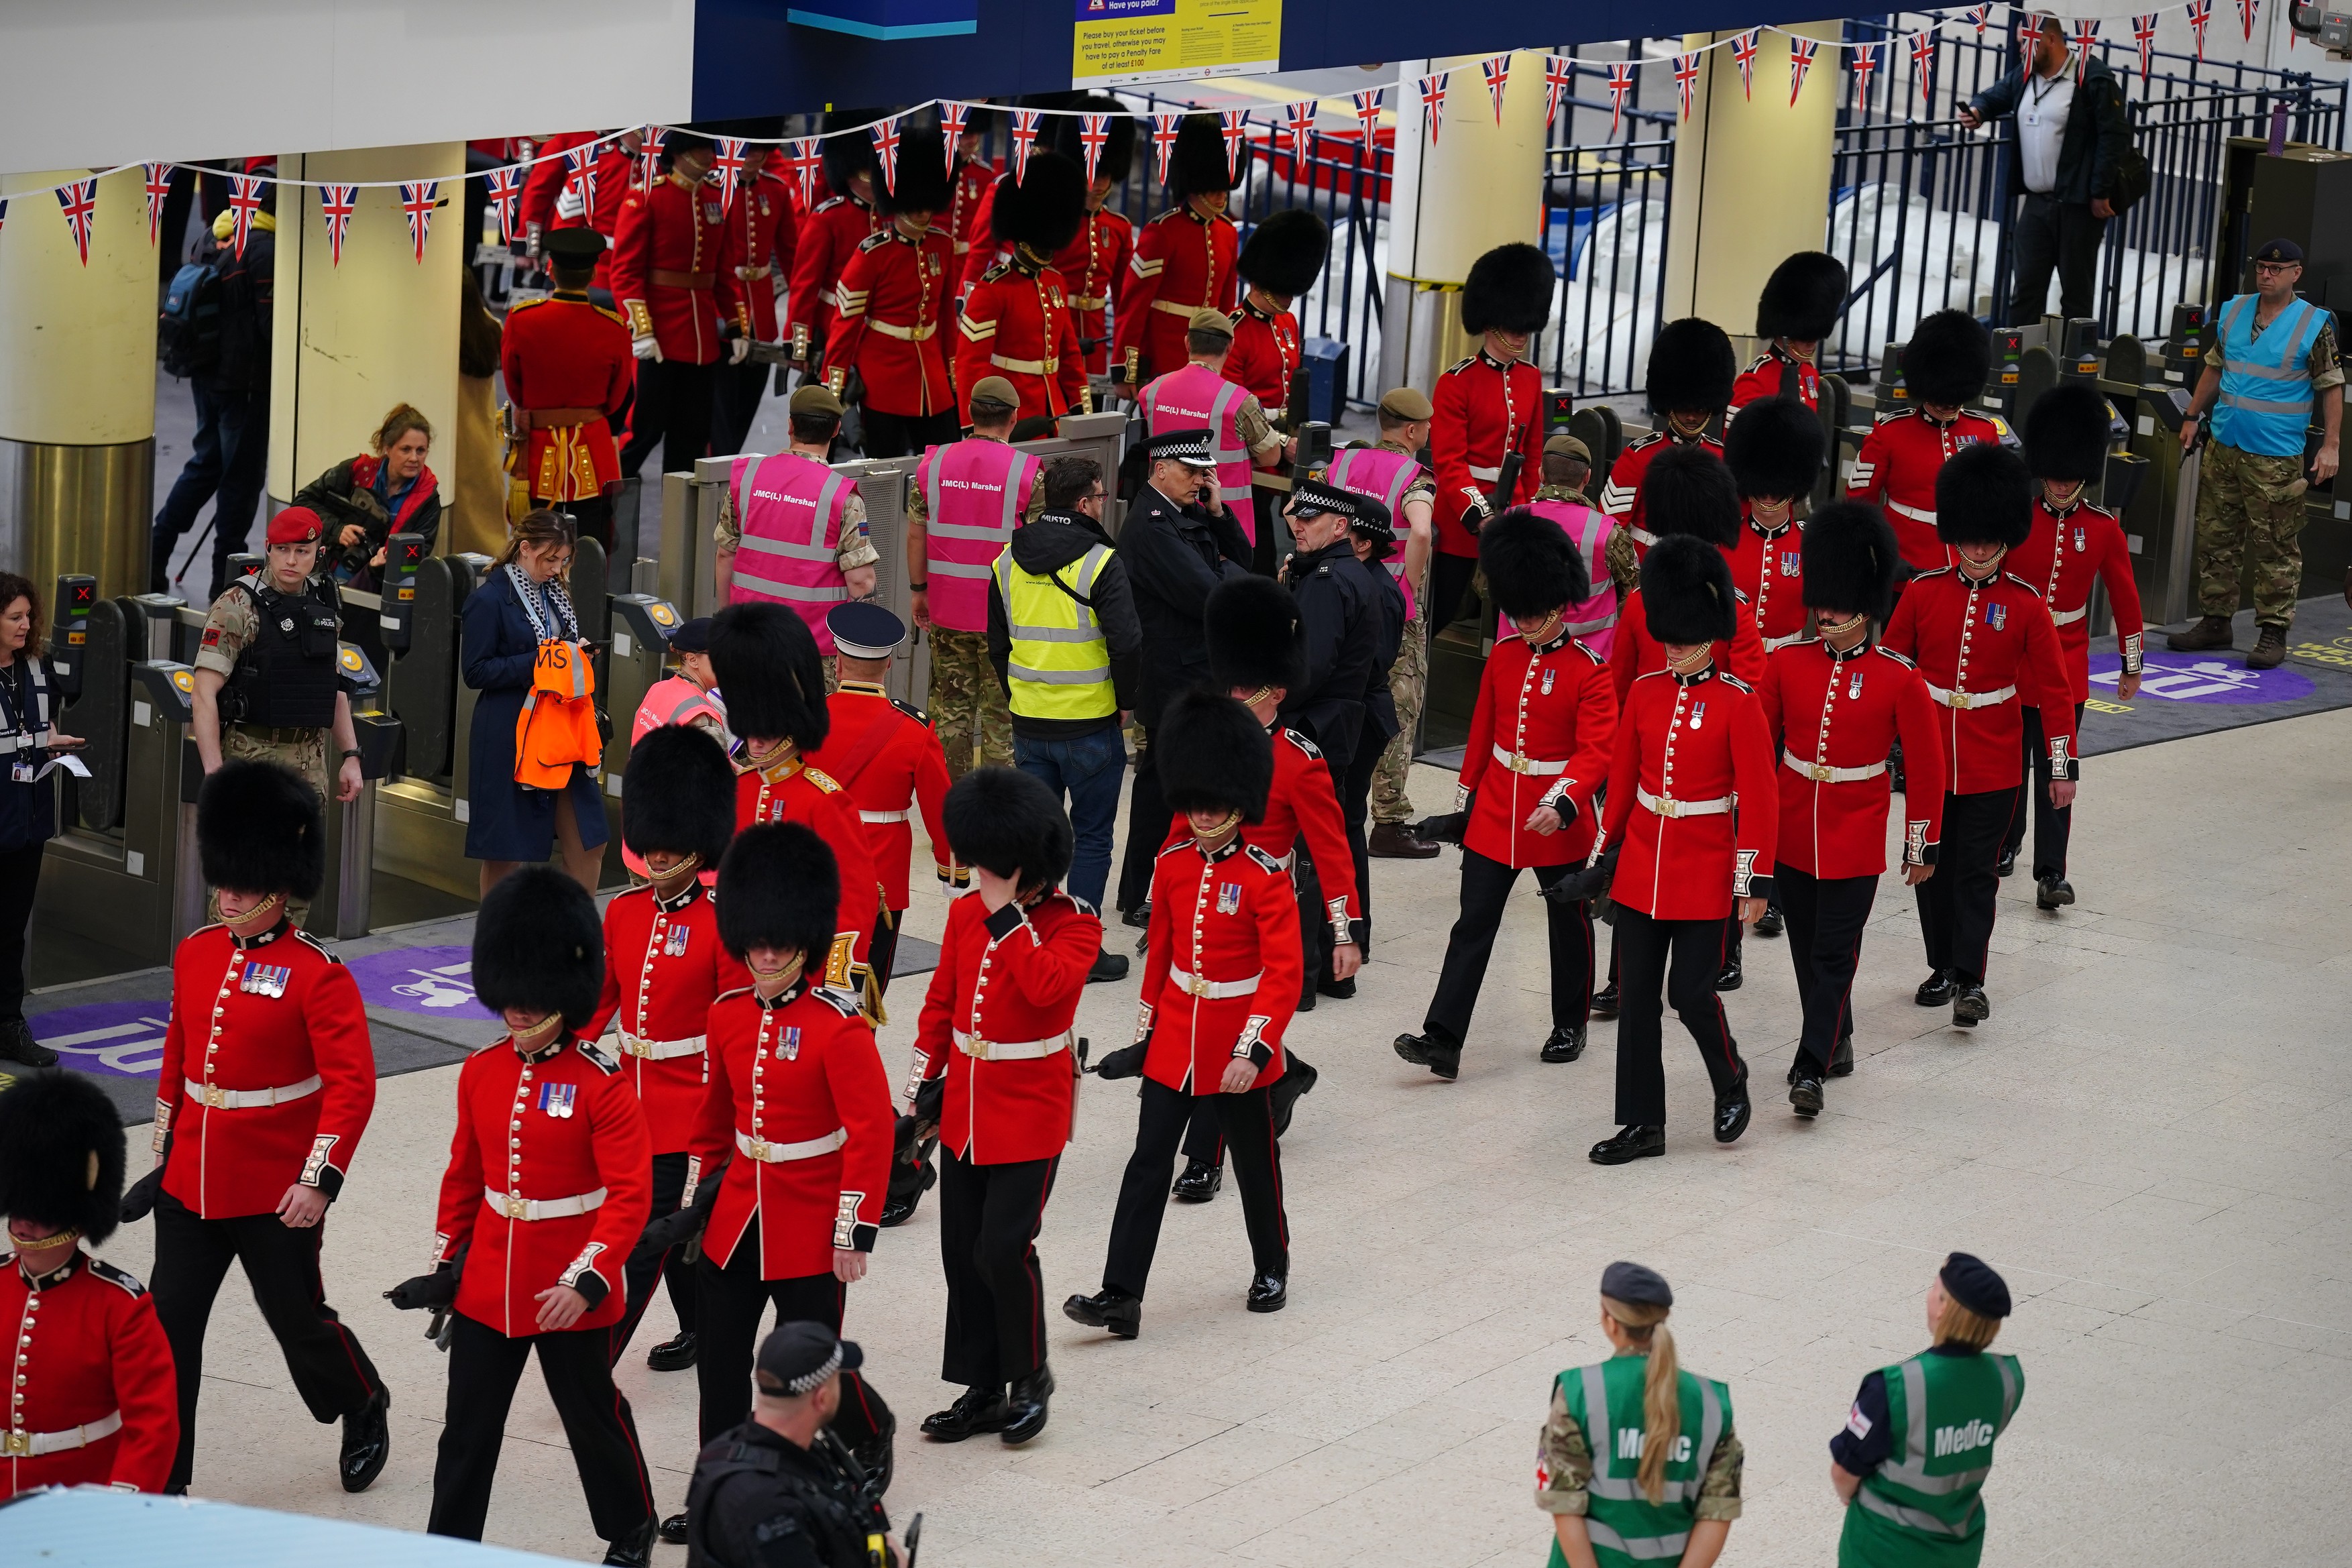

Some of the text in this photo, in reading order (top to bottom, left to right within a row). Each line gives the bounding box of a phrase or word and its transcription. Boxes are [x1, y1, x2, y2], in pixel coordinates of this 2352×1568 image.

[1109, 1, 1125, 9] Have
[1127, 2, 1139, 10] you
[1141, 0, 1160, 9] paid?
[1115, 30, 1128, 38] your
[1129, 27, 1145, 36] ticket
[1113, 39, 1139, 48] otherwise
[1108, 52, 1119, 60] pay
[1127, 49, 1147, 57] Penalty
[1131, 59, 1144, 67] £100
[1156, 404, 1209, 419] JMC(L) Marshal
[941, 480, 1002, 492] JMC(L) Marshal
[1345, 485, 1364, 495] MC(L)
[753, 490, 817, 508] JMC(L) Marshal
[1041, 514, 1071, 525] MUSTO
[1934, 1418, 1995, 1458] Medic
